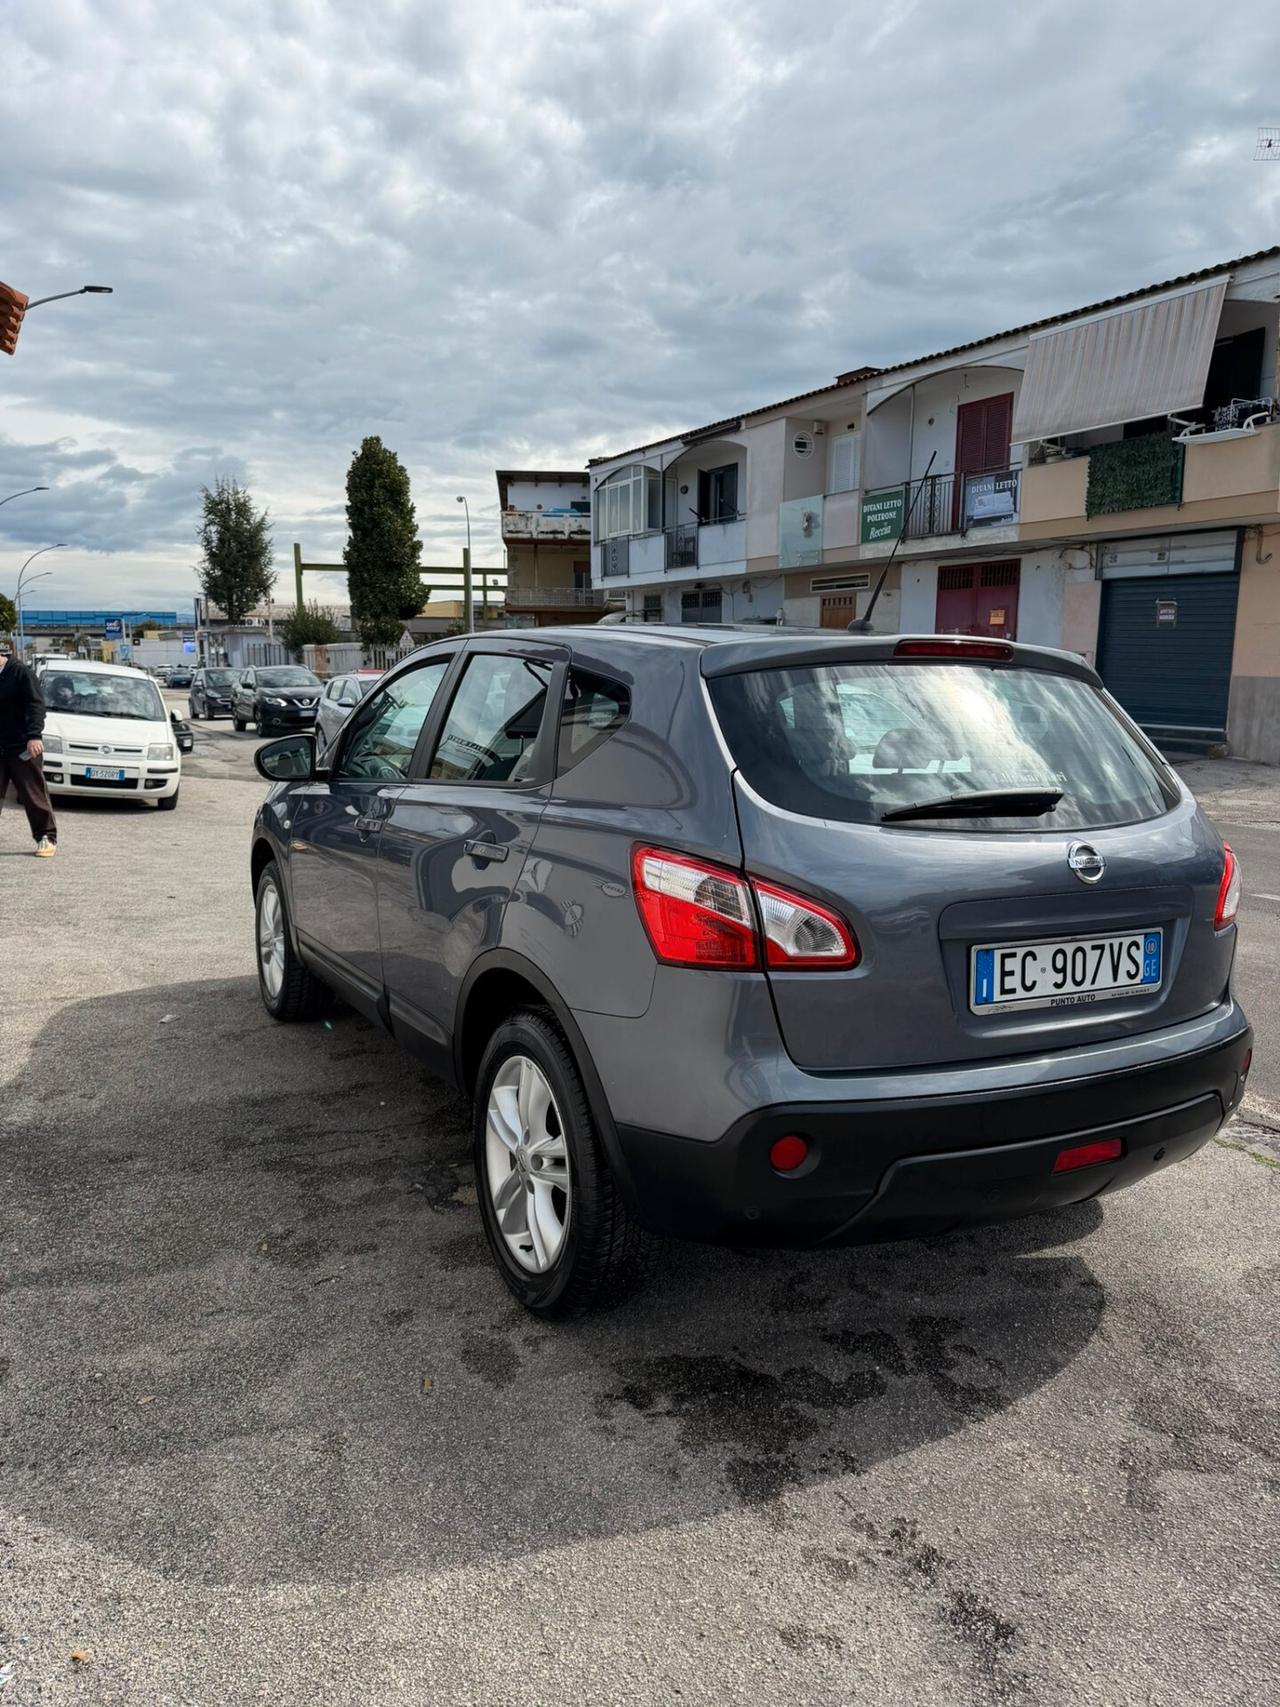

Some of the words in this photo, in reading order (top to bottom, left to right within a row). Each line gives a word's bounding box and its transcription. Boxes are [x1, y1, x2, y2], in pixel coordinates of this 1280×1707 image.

[972, 483, 994, 494] DIVANI
[996, 479, 1018, 490] LETTO
[863, 503, 883, 513] DIVANI
[884, 499, 902, 510] LETTO
[867, 511, 897, 523] POLTRONE
[1000, 950, 1038, 996] EC
[1052, 940, 1141, 990] 907VS
[1144, 959, 1156, 977] GE
[1051, 996, 1076, 1006] PUNTO
[1077, 994, 1096, 1003] AUTO
